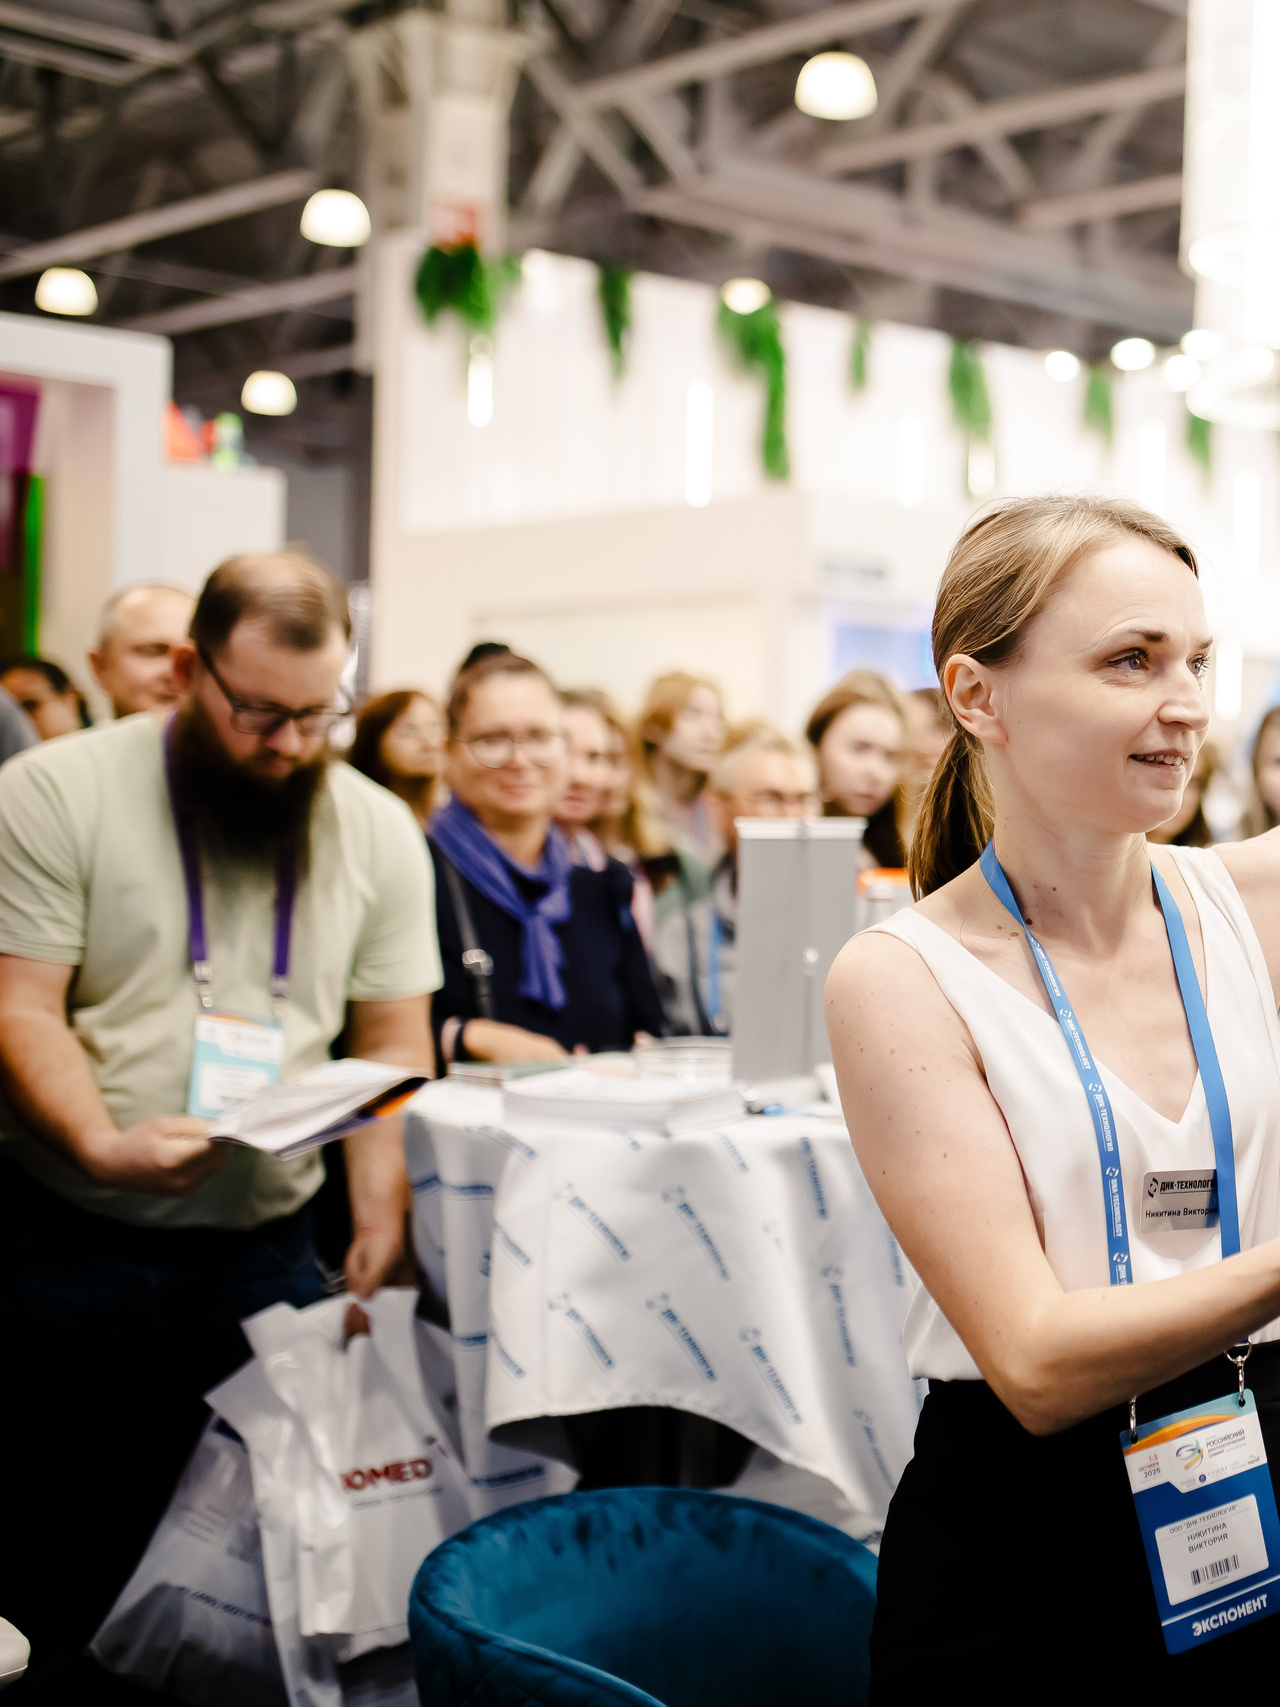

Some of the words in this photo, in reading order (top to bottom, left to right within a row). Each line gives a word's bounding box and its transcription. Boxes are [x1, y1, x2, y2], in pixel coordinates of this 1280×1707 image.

[1146, 1210, 1180, 1218] Никитина
[1187, 1522, 1227, 1542] НИКИТИНА
[1188, 1532, 1228, 1554] ВИКТОРИЯ
[1192, 1593, 1268, 1637] ЭКСПОНЕНТ
